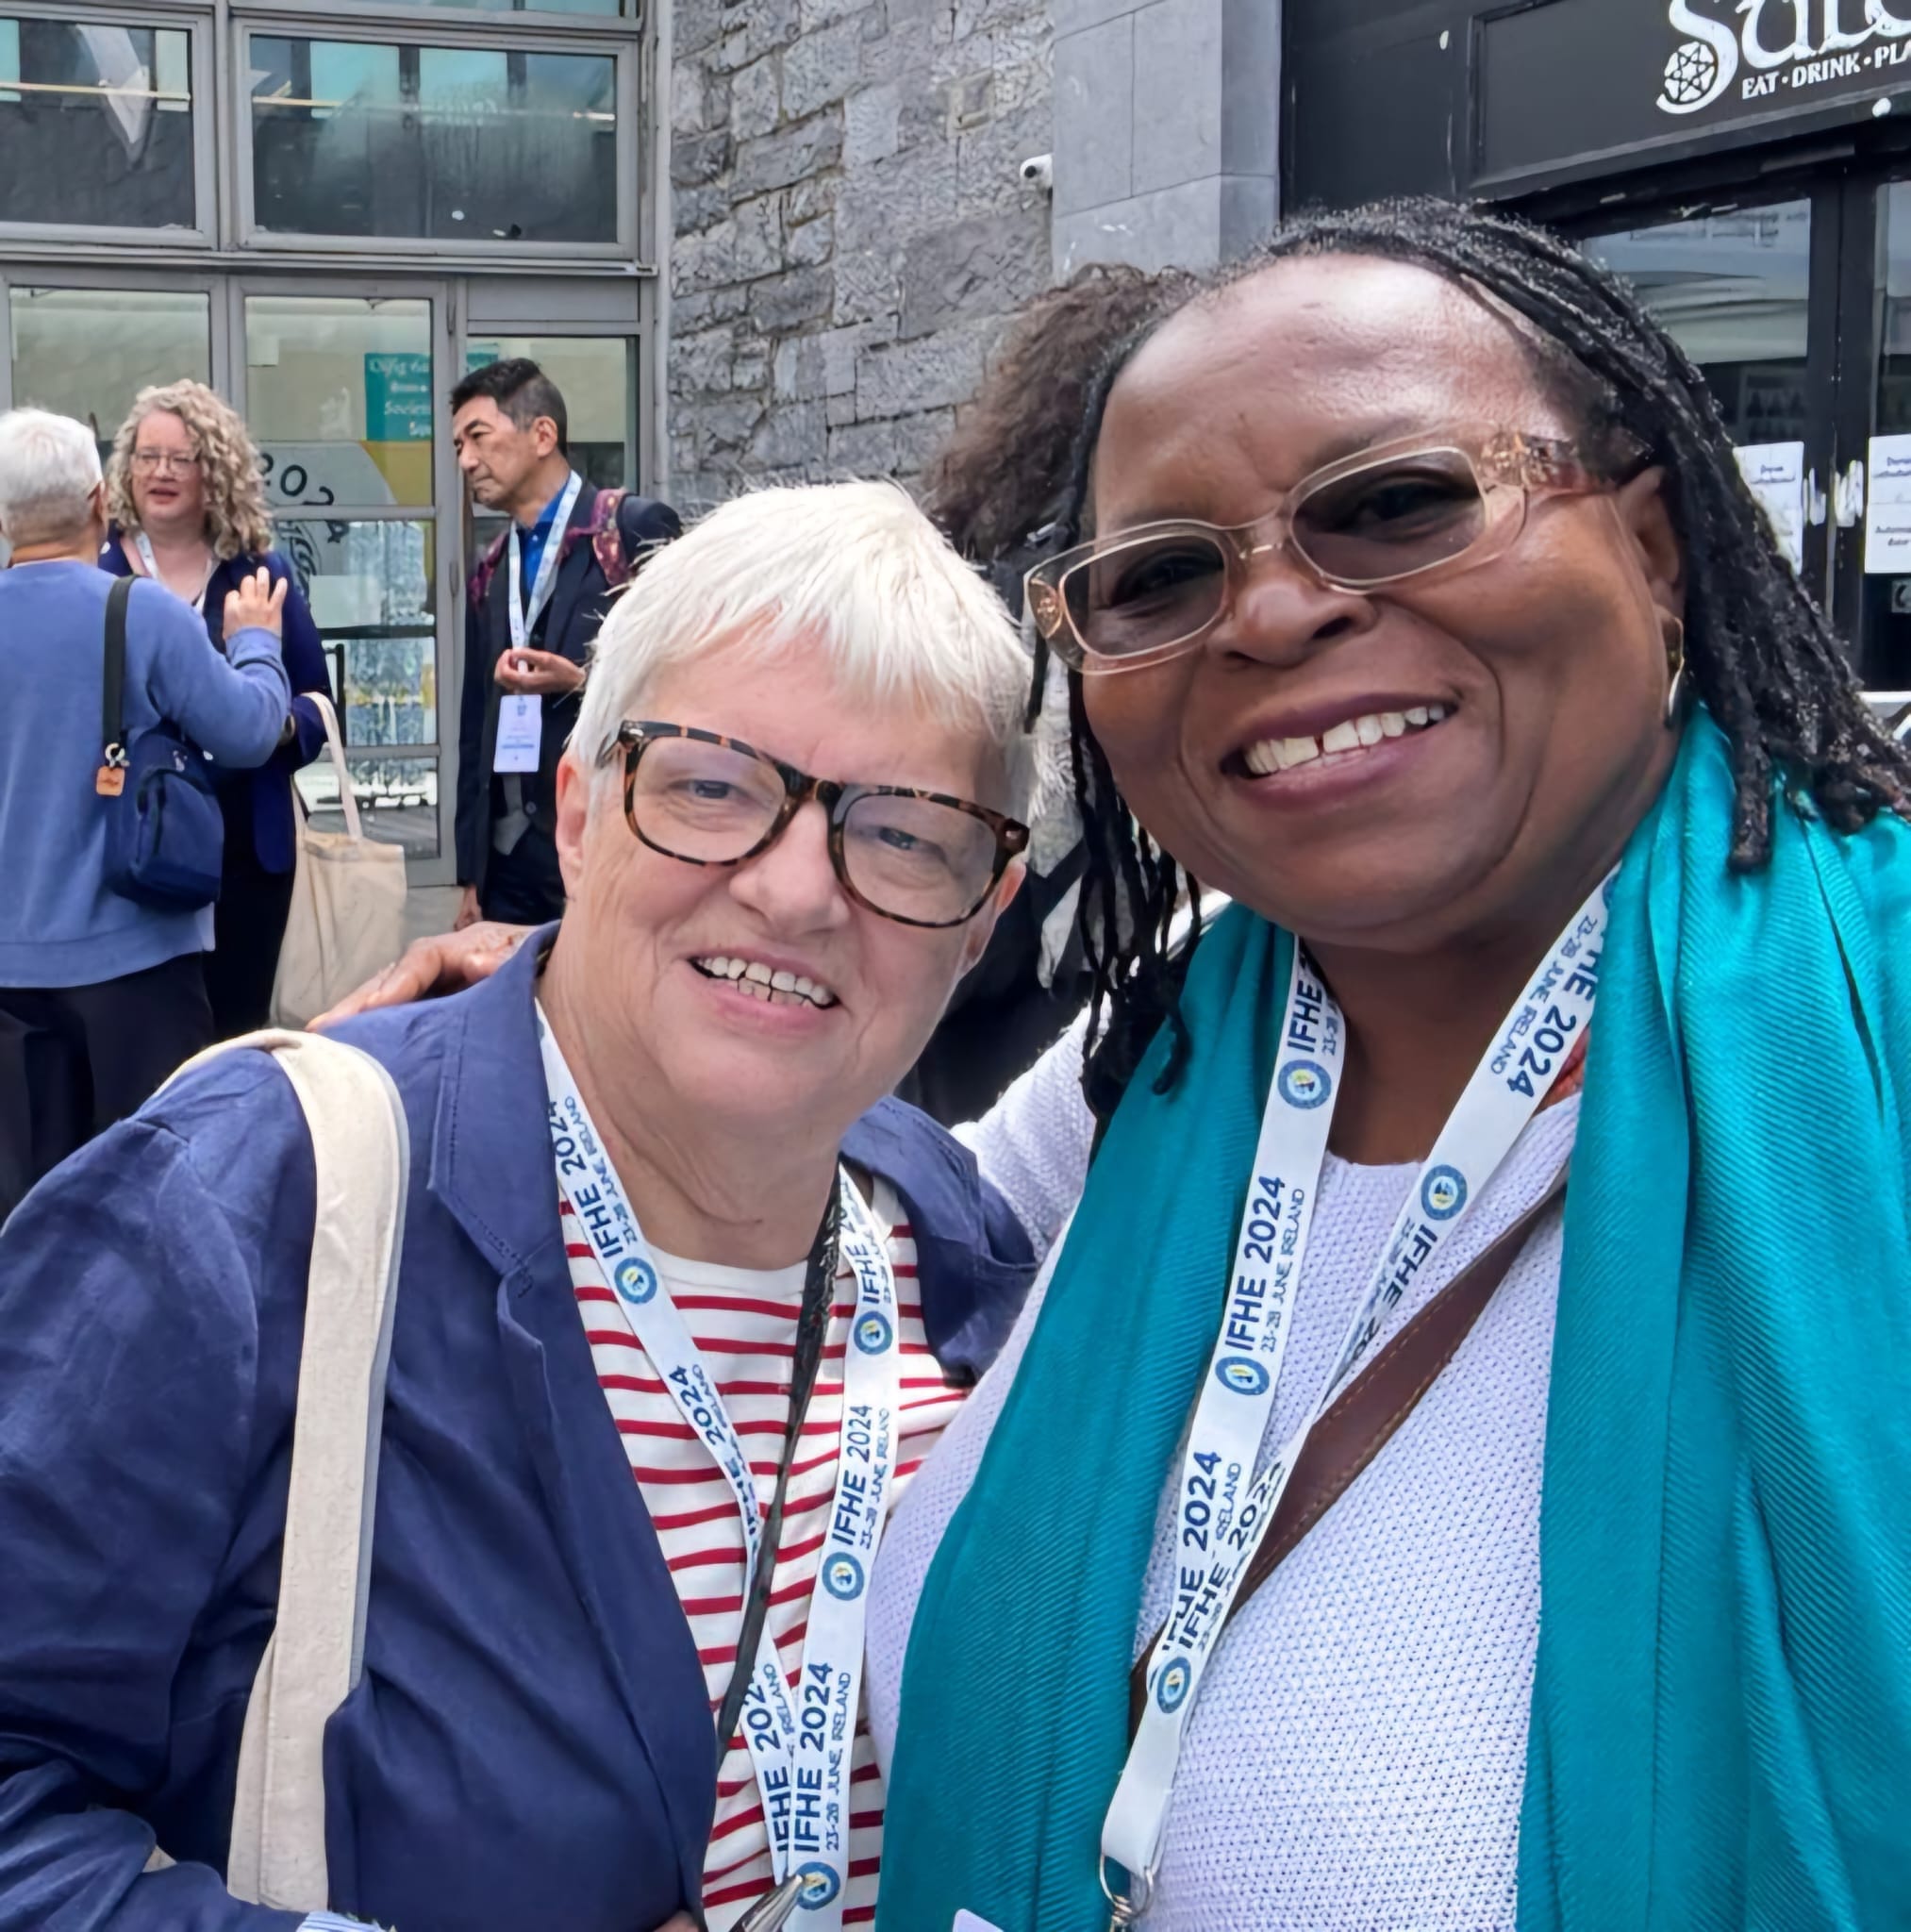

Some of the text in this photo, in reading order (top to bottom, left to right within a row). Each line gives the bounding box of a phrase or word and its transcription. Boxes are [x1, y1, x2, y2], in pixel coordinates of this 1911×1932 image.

[1287, 979, 1322, 1054] IFHE
[1529, 961, 1565, 1004] JUNE
[1490, 1004, 1537, 1074] IRELAND
[1506, 1004, 1577, 1097] 2024
[574, 1182, 623, 1258] IFHE
[1280, 1188, 1305, 1257] IRELAND
[844, 1242, 881, 1305] IFHE
[1225, 1175, 1286, 1352] IFHE 2024
[1271, 1260, 1293, 1307] JUNE
[1382, 1224, 1438, 1310] IFHE
[668, 1364, 727, 1446] 2024
[831, 1405, 873, 1547] IFHE 2024
[1183, 1451, 1222, 1552] 2024
[1178, 1561, 1231, 1650] IFHE
[743, 1682, 782, 1754] 202
[831, 1672, 852, 1741] IRELAND
[793, 1662, 834, 1853] IFHE 2024
[826, 1747, 844, 1791] JUNE
